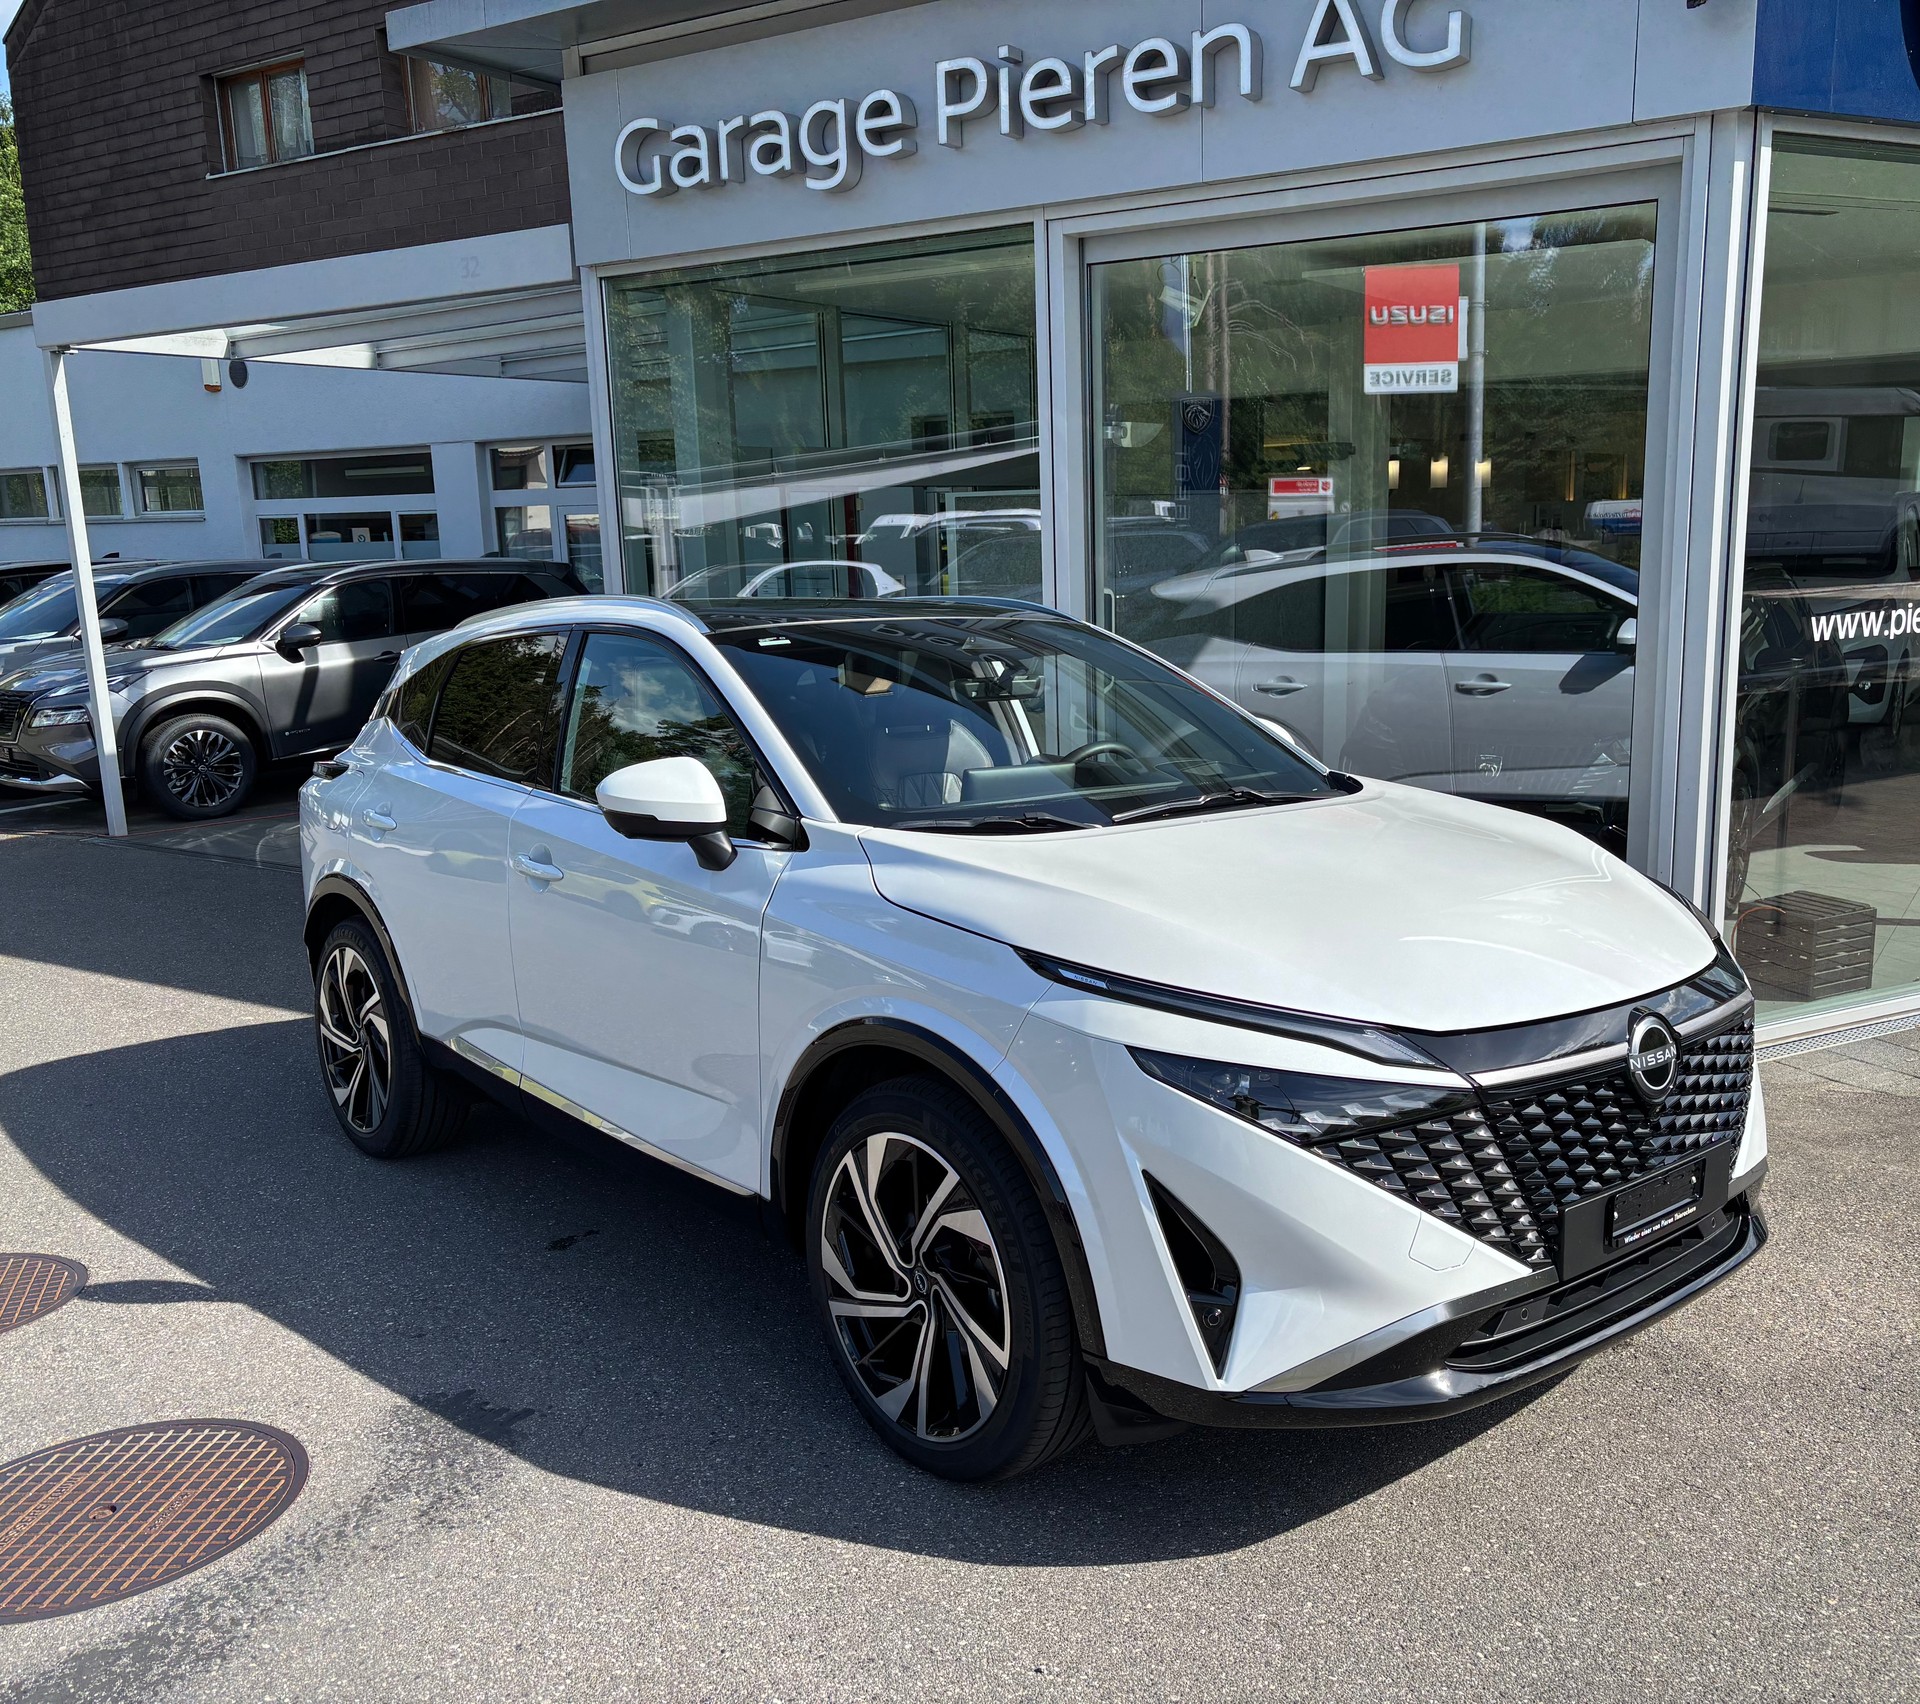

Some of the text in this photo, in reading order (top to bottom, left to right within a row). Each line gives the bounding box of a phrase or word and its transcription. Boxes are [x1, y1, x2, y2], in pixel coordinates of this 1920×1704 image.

[614, 0, 1468, 196] Garage Pieren AG
[460, 255, 481, 279] 32
[1074, 974, 1098, 986] NISSAN
[1630, 1047, 1677, 1071] NISSAN
[950, 1140, 1020, 1266] MICHELIN
[1020, 1286, 1032, 1345] PRIMACY
